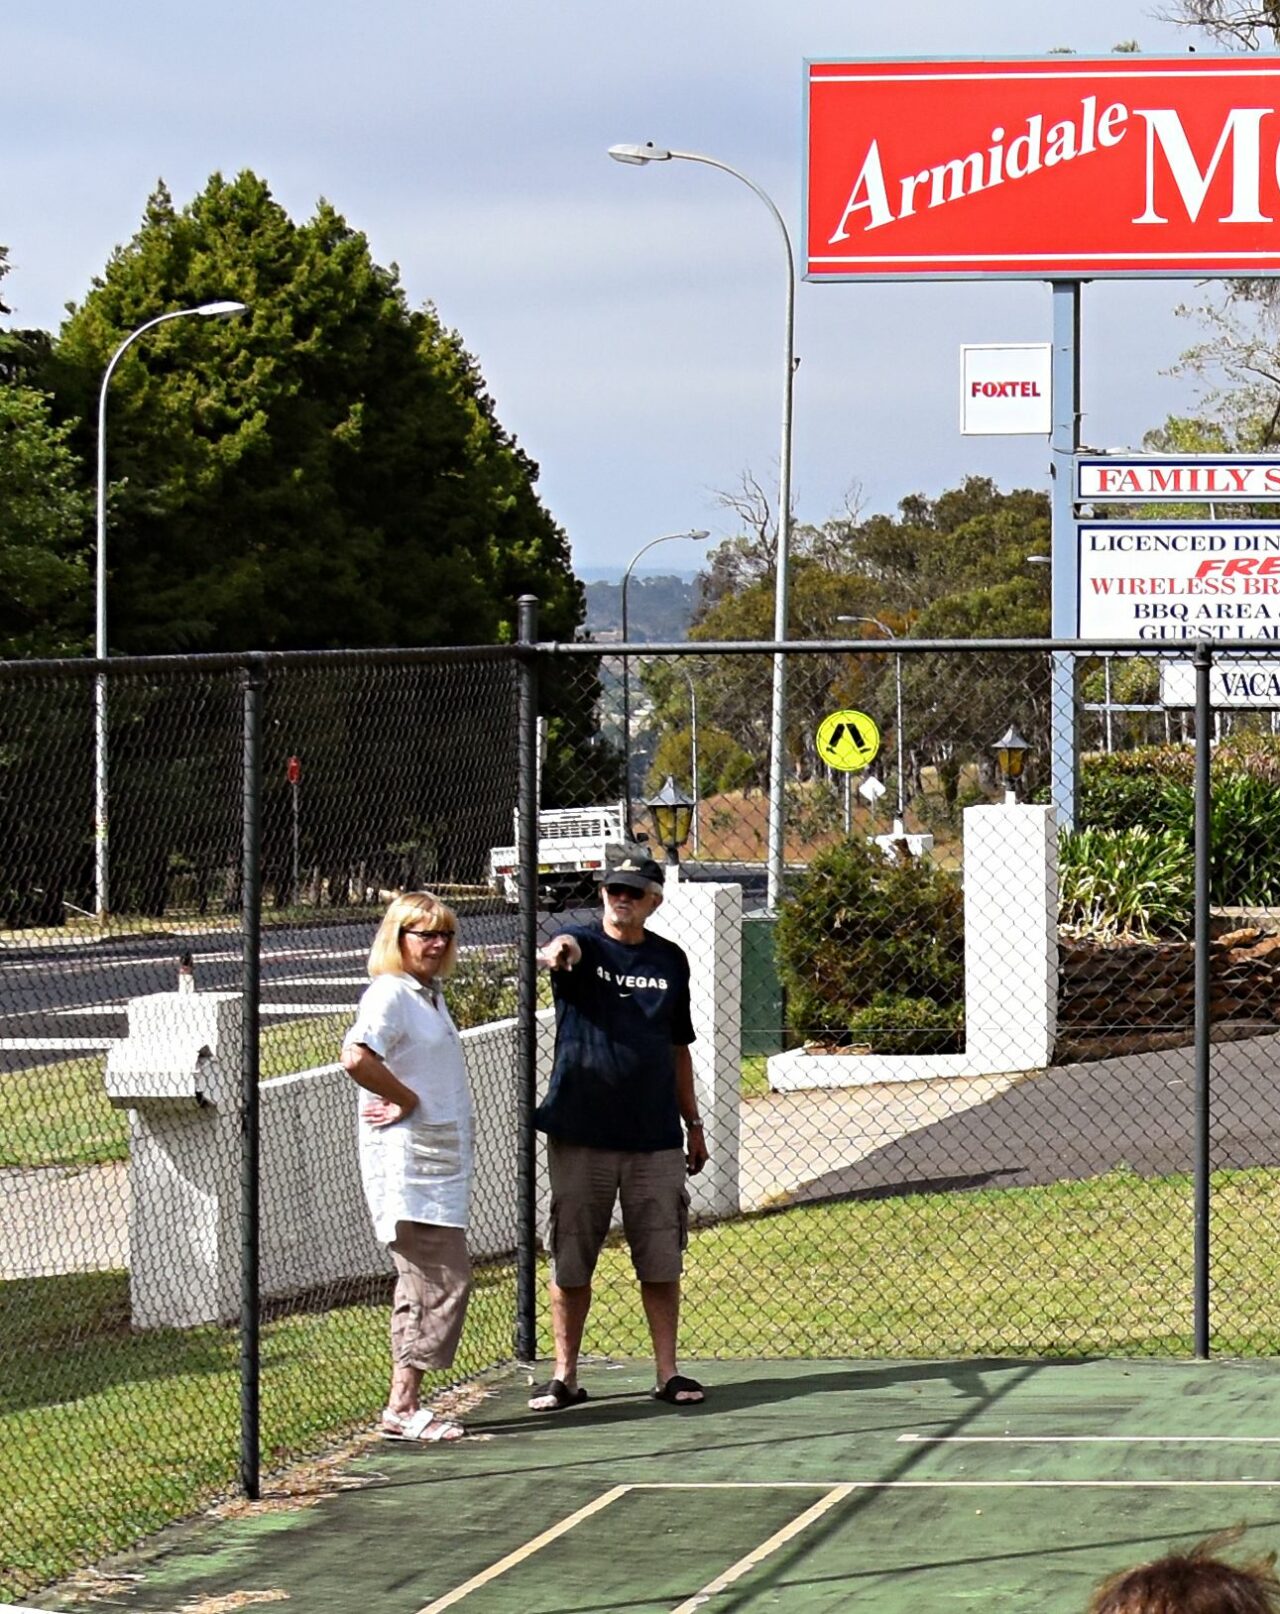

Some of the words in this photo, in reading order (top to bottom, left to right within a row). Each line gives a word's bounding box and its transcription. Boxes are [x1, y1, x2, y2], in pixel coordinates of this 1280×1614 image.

[829, 96, 1129, 244] Armidale
[971, 381, 1041, 397] FOXTEL
[1097, 468, 1255, 492] FAMILY
[1090, 535, 1226, 552] LICENCED
[1090, 577, 1236, 596] WIRELESS
[1133, 603, 1189, 622] BBQ
[1196, 603, 1271, 619] AREA
[1138, 624, 1231, 639] GUEST
[615, 975, 668, 989] VEGAS
